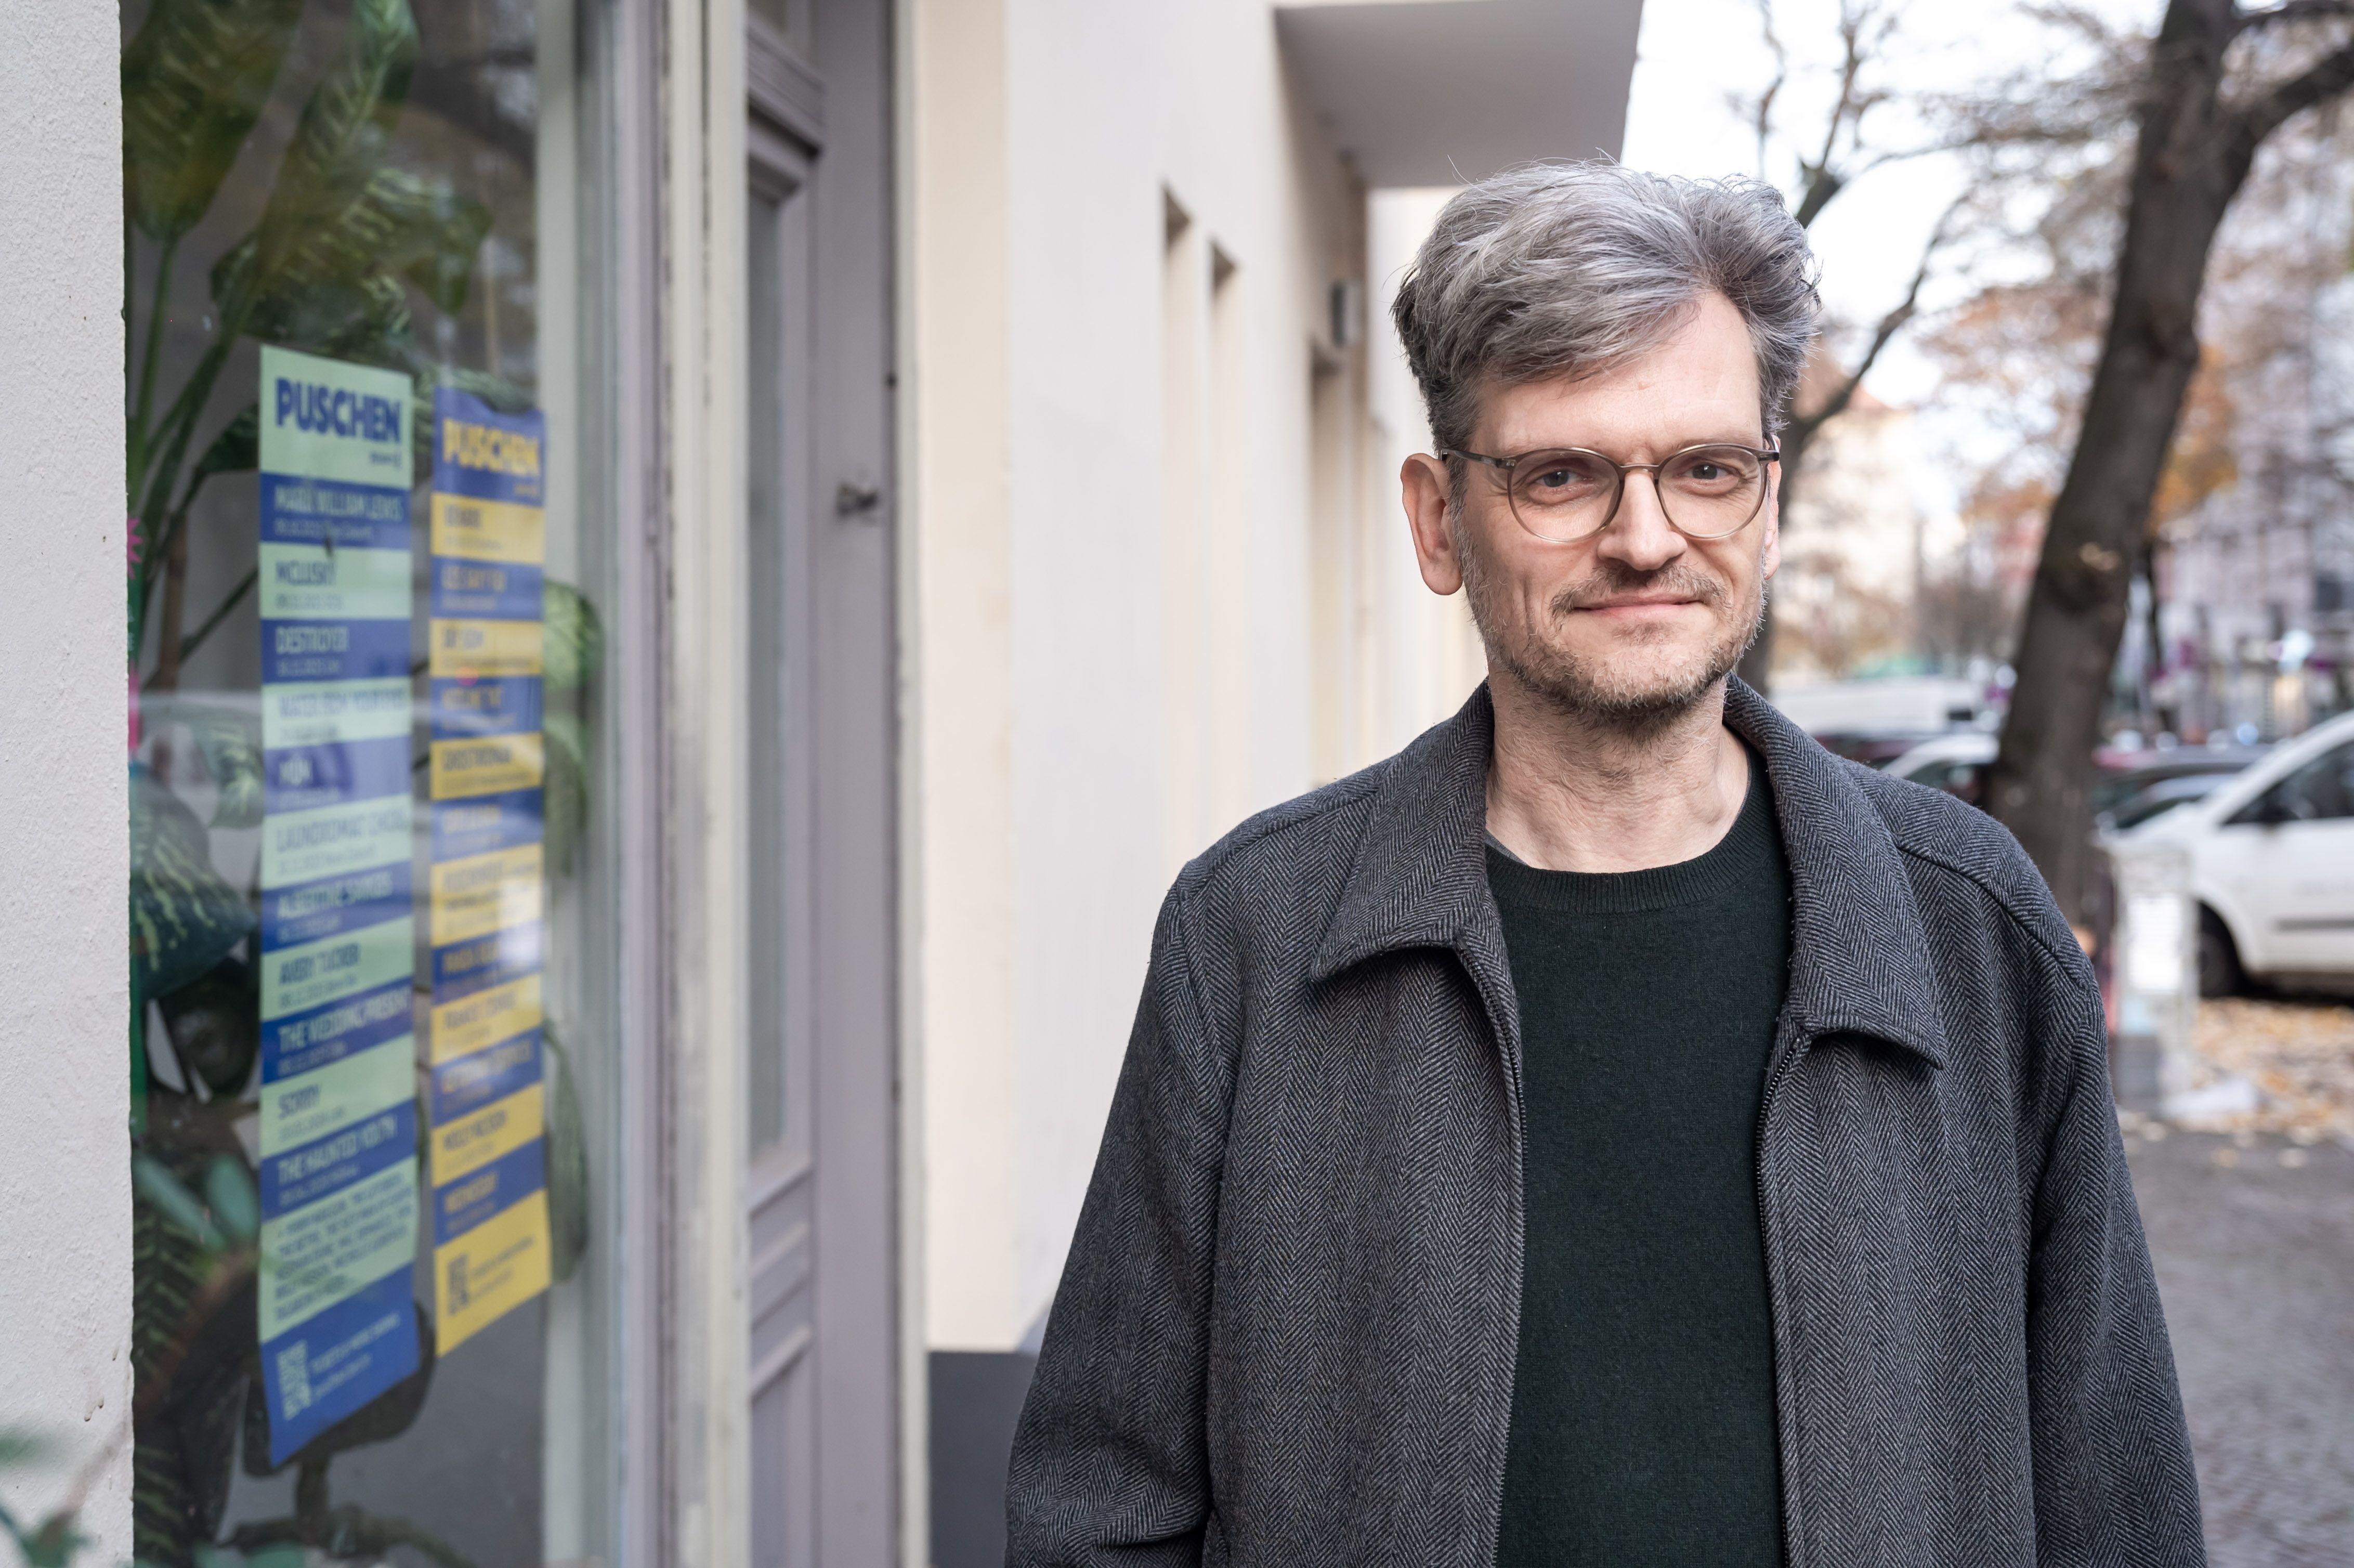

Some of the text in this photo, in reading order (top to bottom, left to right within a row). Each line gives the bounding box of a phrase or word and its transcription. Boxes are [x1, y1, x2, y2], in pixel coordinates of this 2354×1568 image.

[276, 377, 402, 443] PUSCHEN
[442, 418, 540, 477] PUSCHEN
[278, 1024, 307, 1052] THE
[278, 1158, 305, 1185] THE
